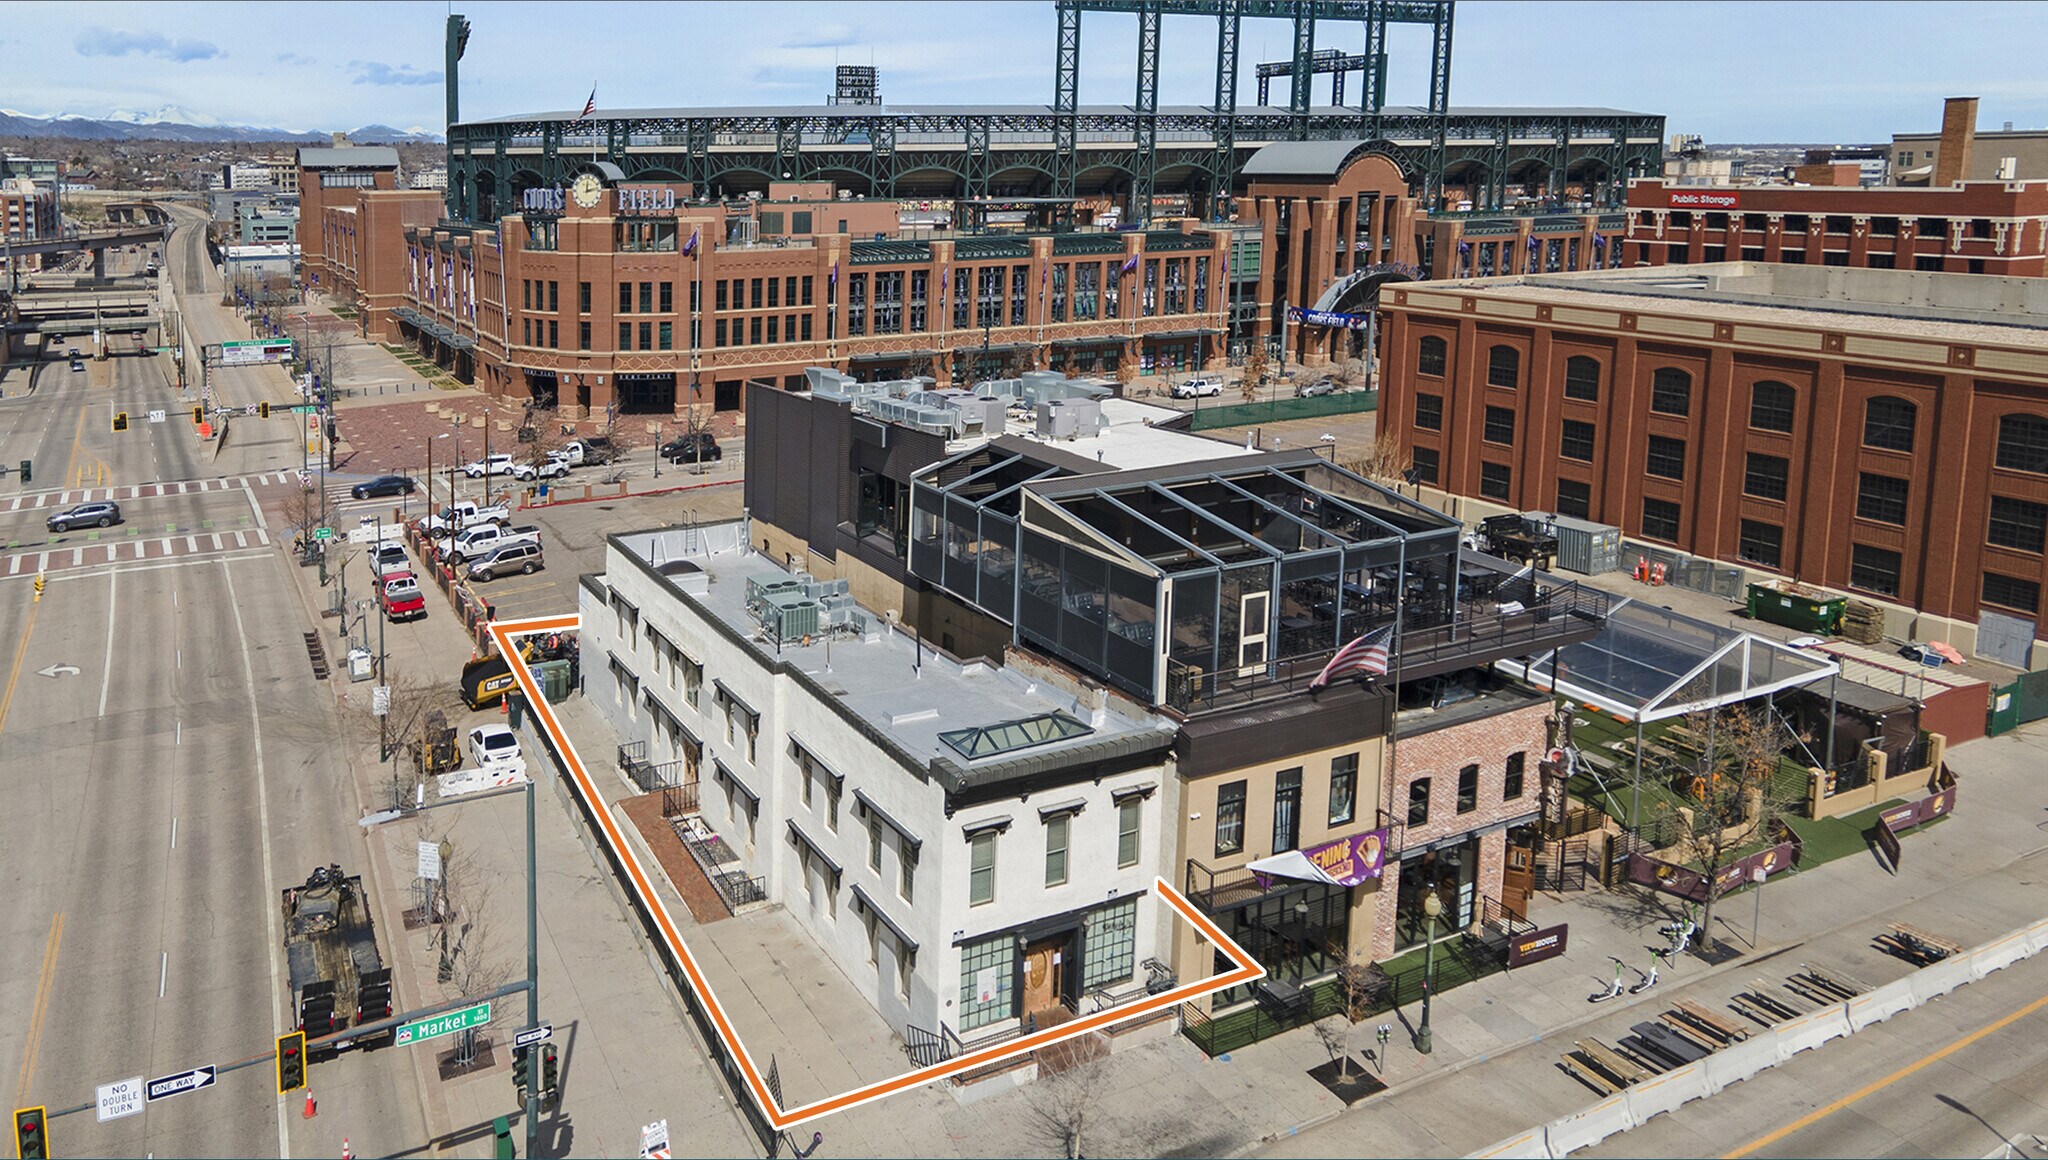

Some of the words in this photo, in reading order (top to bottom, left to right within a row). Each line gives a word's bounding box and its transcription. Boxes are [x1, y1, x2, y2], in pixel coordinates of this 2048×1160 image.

[523, 187, 565, 210] COORS
[618, 189, 675, 210] FIELD
[1672, 194, 1699, 203] Public
[1700, 195, 1736, 206] Storage
[486, 679, 500, 690] CAT
[1310, 840, 1351, 869] ENING
[418, 1014, 467, 1038] Market
[531, 1031, 541, 1039] WAY
[112, 1083, 128, 1095] NO
[154, 1081, 173, 1094] ONE
[175, 1076, 195, 1088] WAY
[102, 1090, 138, 1107] DOUBLE
[109, 1102, 133, 1116] TURN
